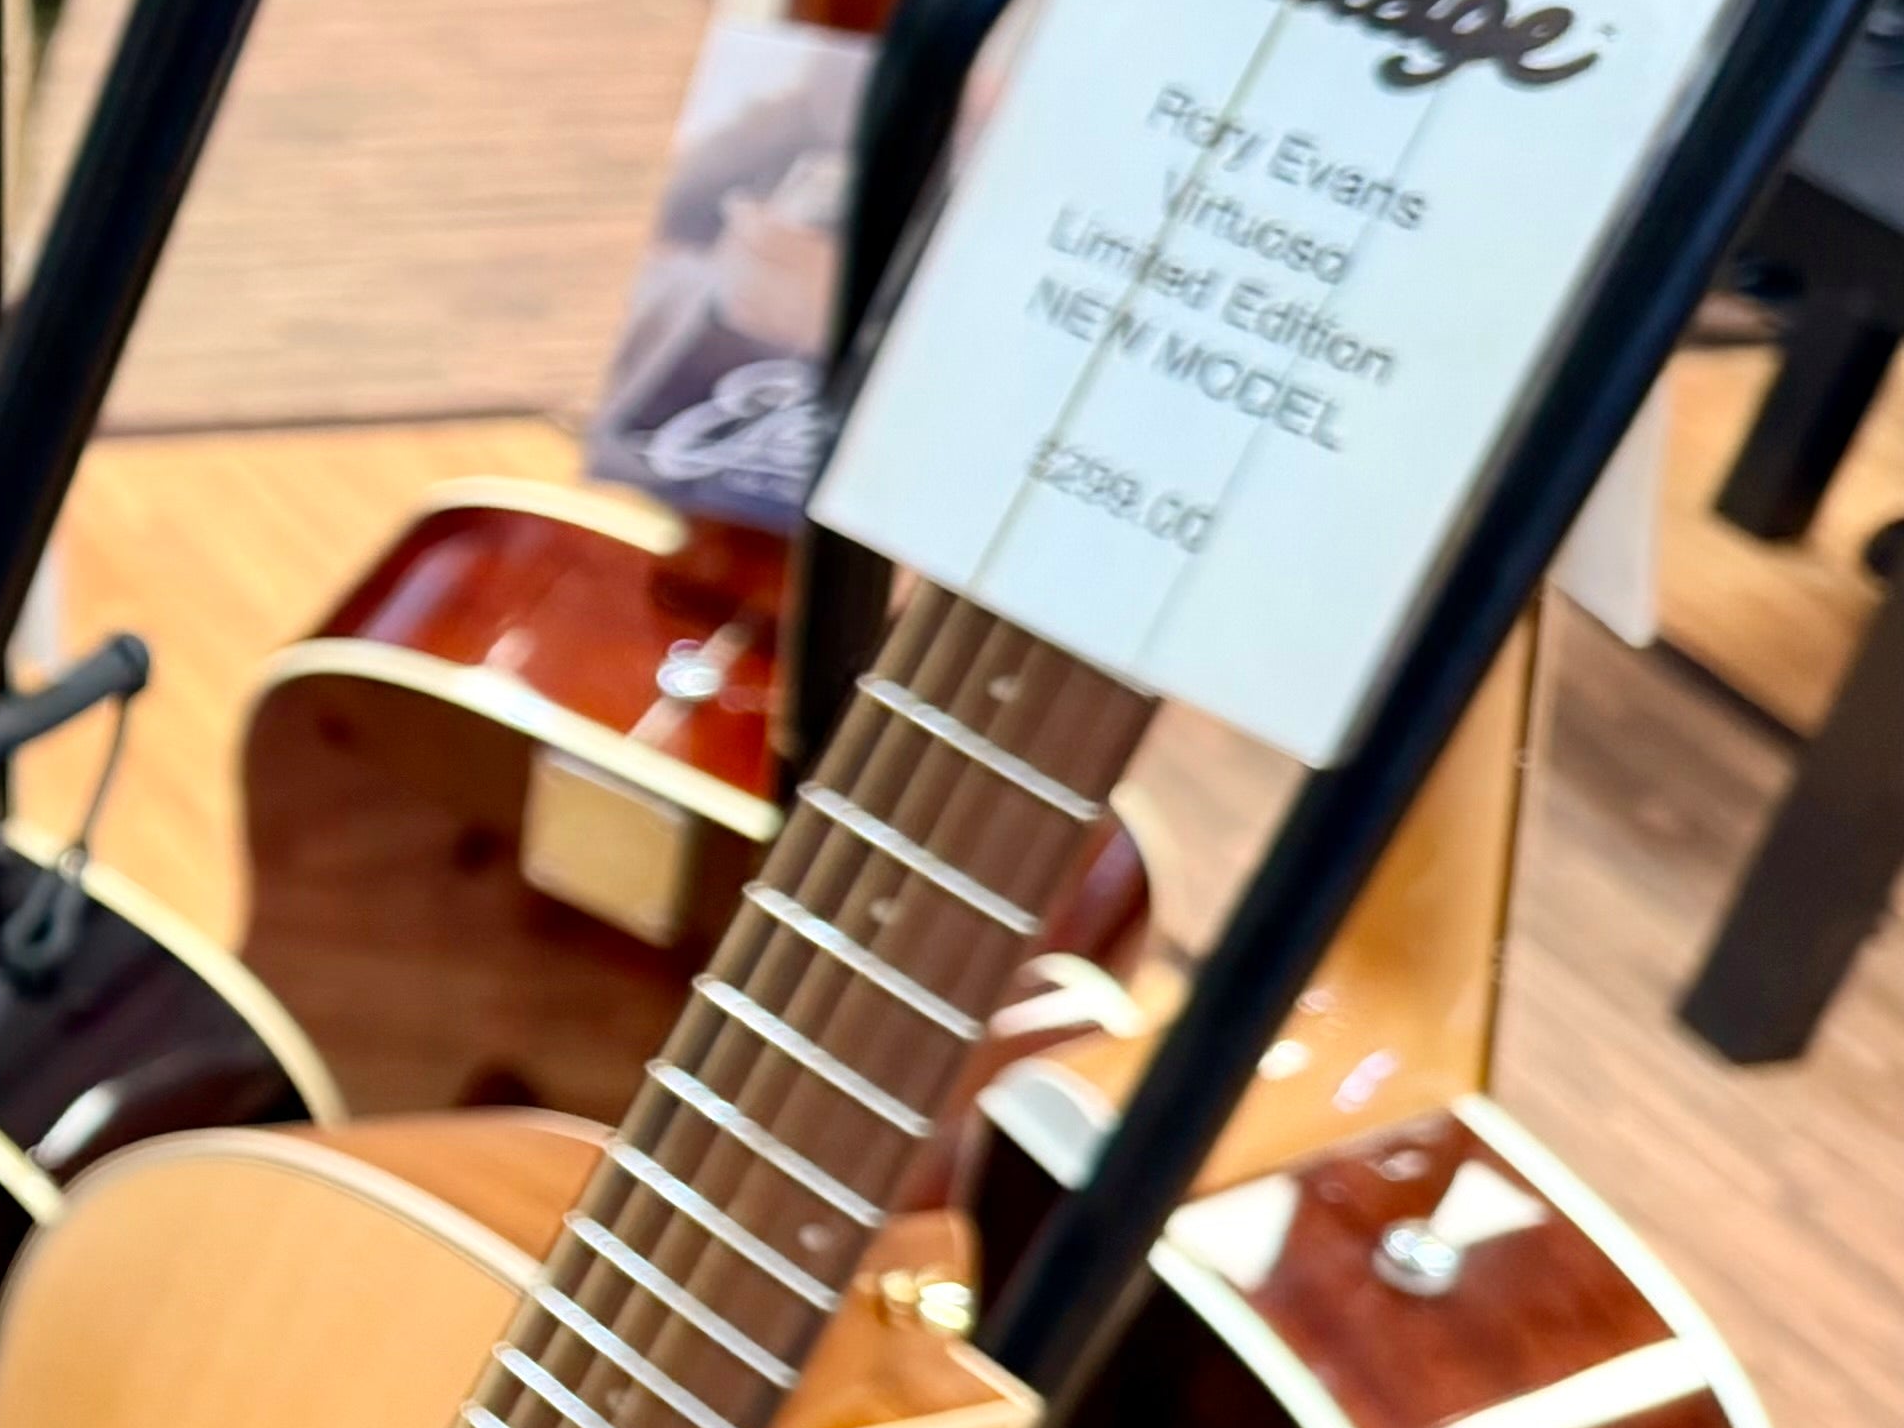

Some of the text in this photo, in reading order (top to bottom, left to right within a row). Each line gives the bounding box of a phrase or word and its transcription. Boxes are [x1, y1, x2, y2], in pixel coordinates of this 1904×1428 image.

[1267, 132, 1427, 230] Evans
[1025, 274, 1346, 453] NEW MODEL
[1220, 274, 1397, 384] Edition
